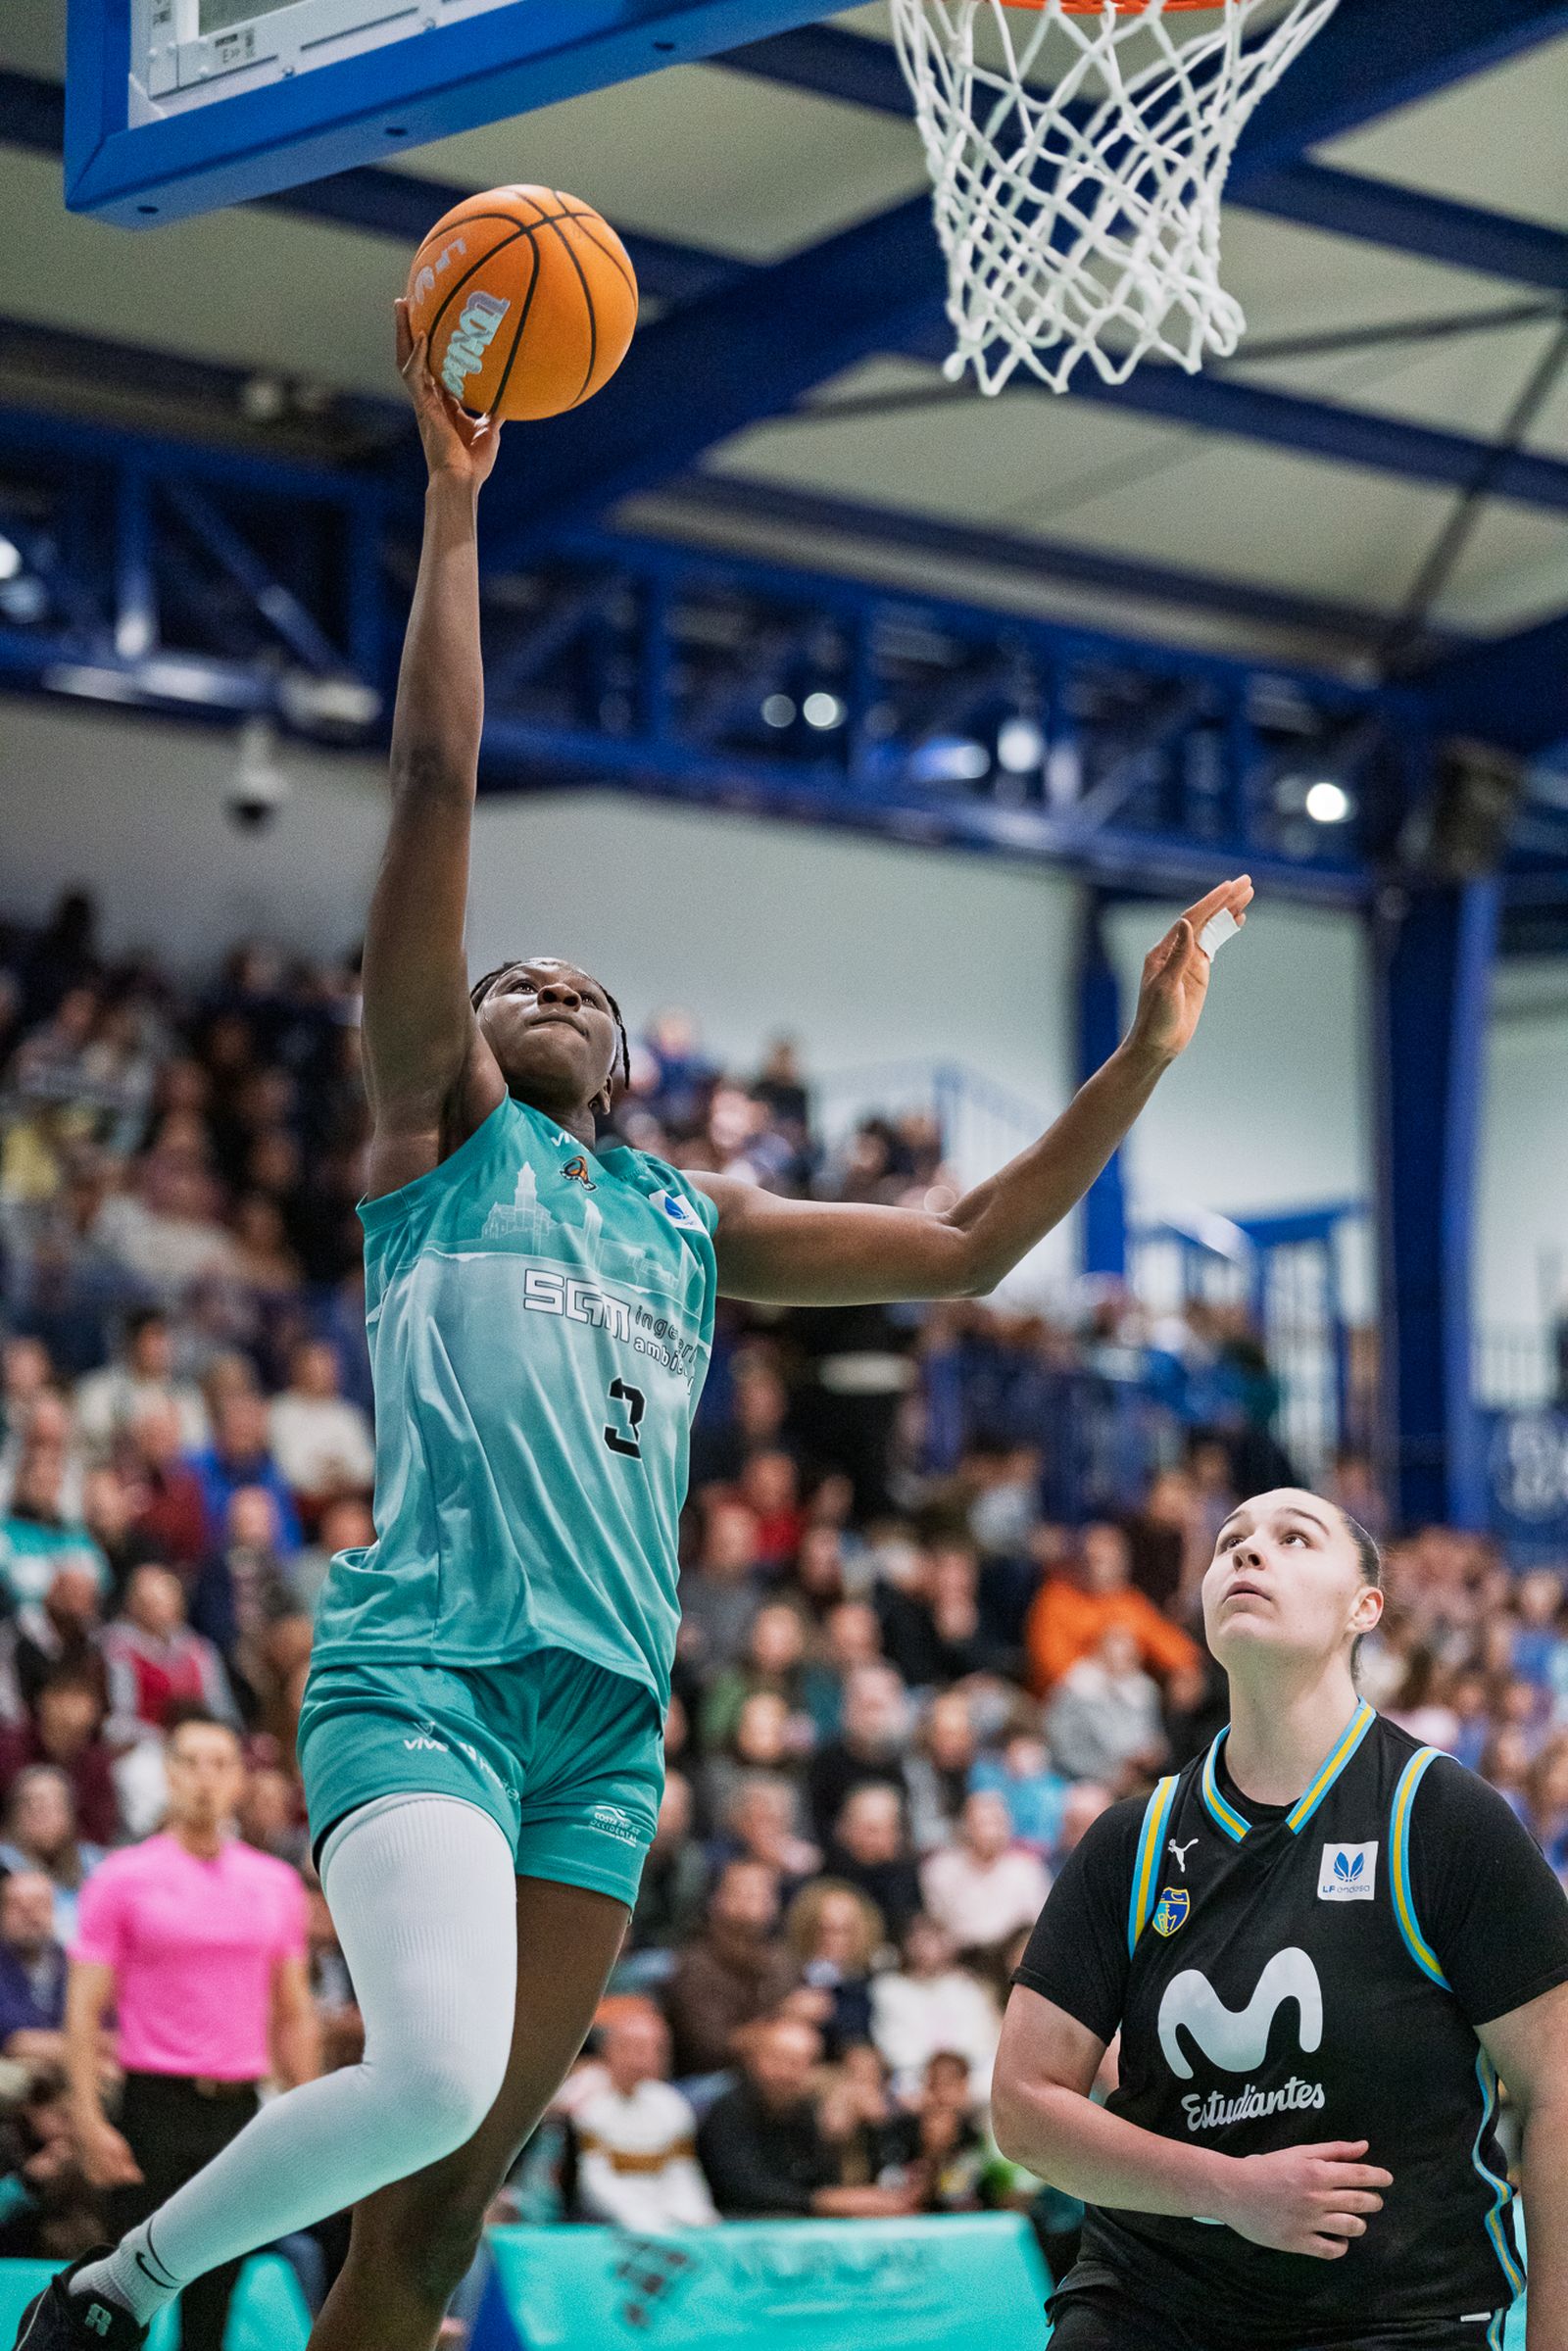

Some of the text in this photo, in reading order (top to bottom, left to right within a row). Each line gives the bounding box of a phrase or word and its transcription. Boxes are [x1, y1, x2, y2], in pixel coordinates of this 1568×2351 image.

[604, 1378, 645, 1459] 3
[1322, 1885, 1336, 1893] LF
[1181, 2076, 1325, 2131] Estudiantes
